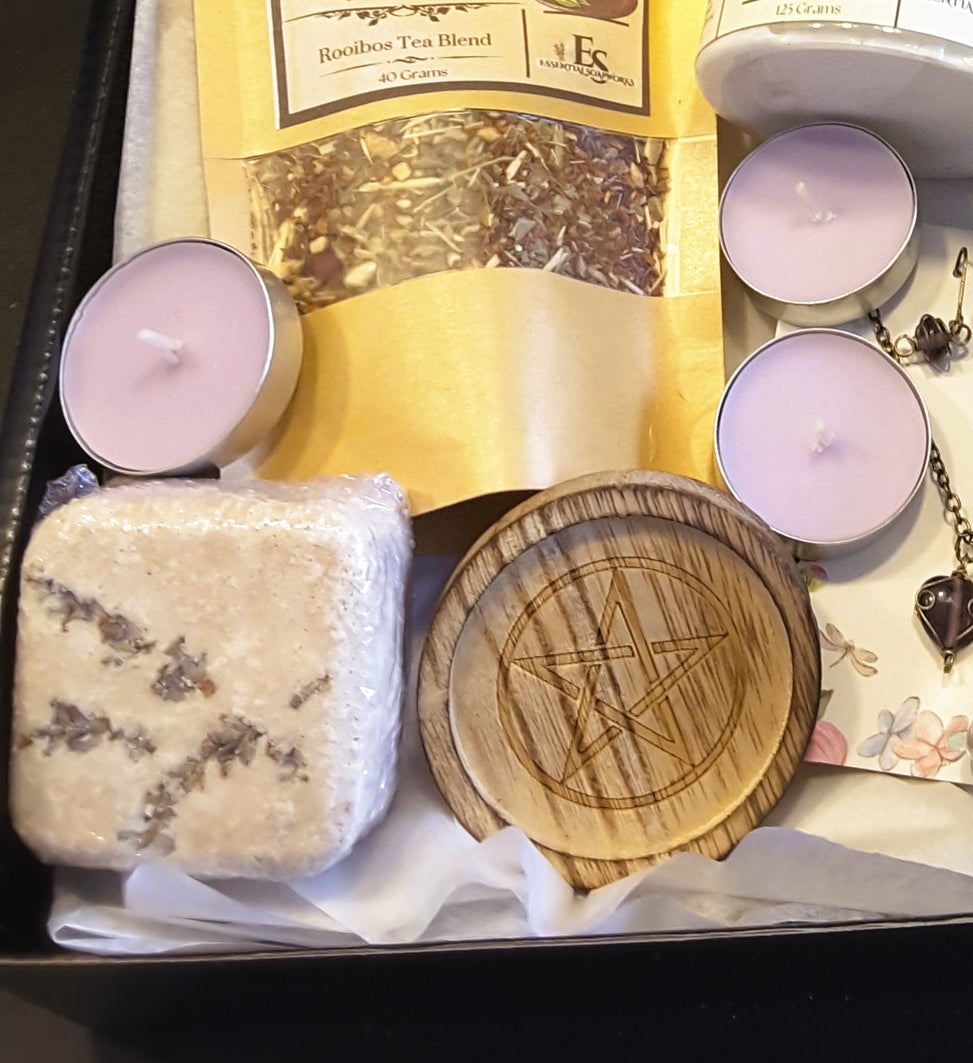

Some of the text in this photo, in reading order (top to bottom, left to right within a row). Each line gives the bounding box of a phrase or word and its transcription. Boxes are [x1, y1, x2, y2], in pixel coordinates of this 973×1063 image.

[776, 3, 842, 16] 125 Grams
[319, 33, 492, 64] Rooibos Tea Blend
[378, 67, 448, 84] 40 Grams
